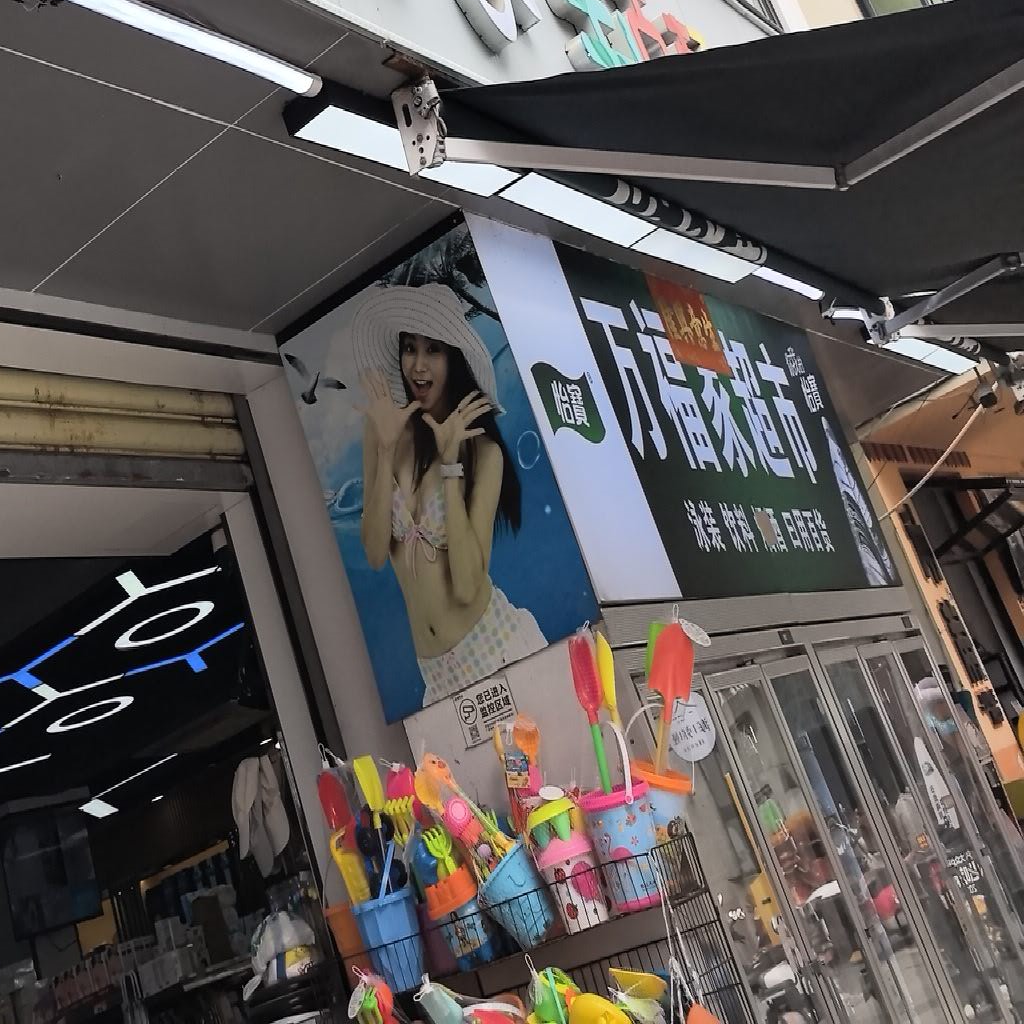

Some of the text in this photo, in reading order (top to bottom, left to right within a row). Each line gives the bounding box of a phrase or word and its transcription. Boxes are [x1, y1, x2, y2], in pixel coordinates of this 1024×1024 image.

[580, 296, 818, 484] 万福家超市
[684, 499, 726, 552] 泳装
[719, 502, 759, 552] 饮料
[781, 508, 835, 552] 日用百货
